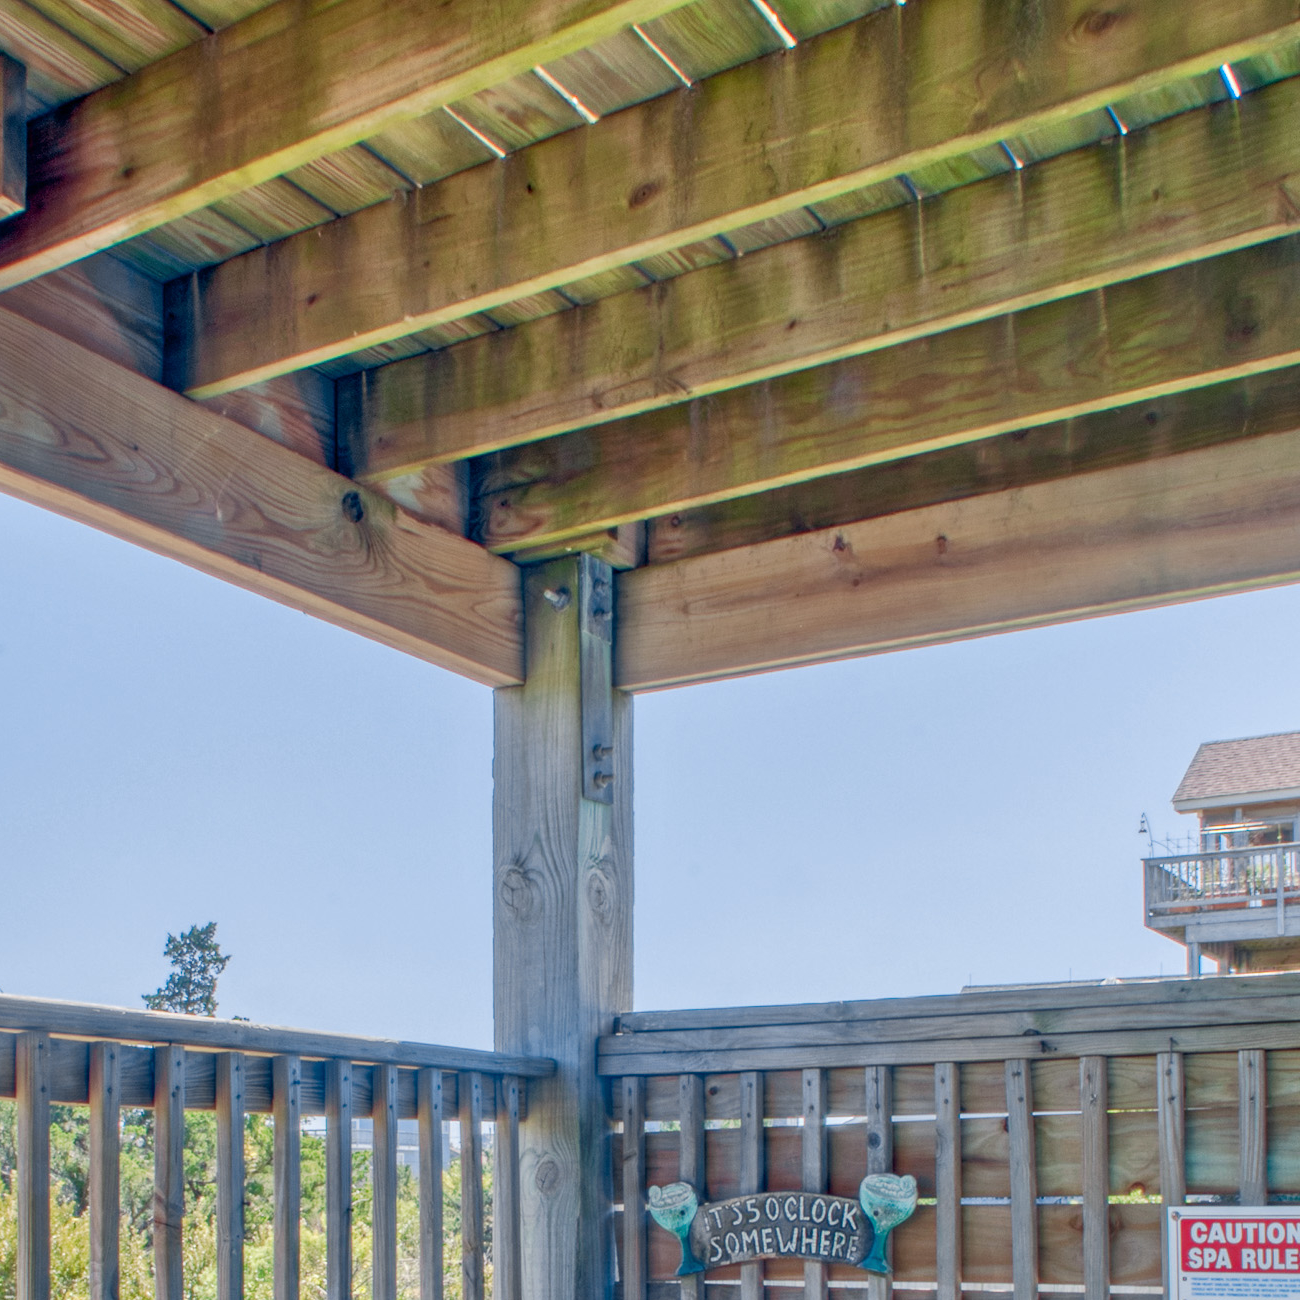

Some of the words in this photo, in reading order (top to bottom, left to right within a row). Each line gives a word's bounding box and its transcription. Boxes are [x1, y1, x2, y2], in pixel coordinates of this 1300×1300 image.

[765, 1196, 858, 1231] O'CLOCK
[710, 1227, 860, 1262] SOMEWHERE
[1188, 1247, 1232, 1269] SPA
